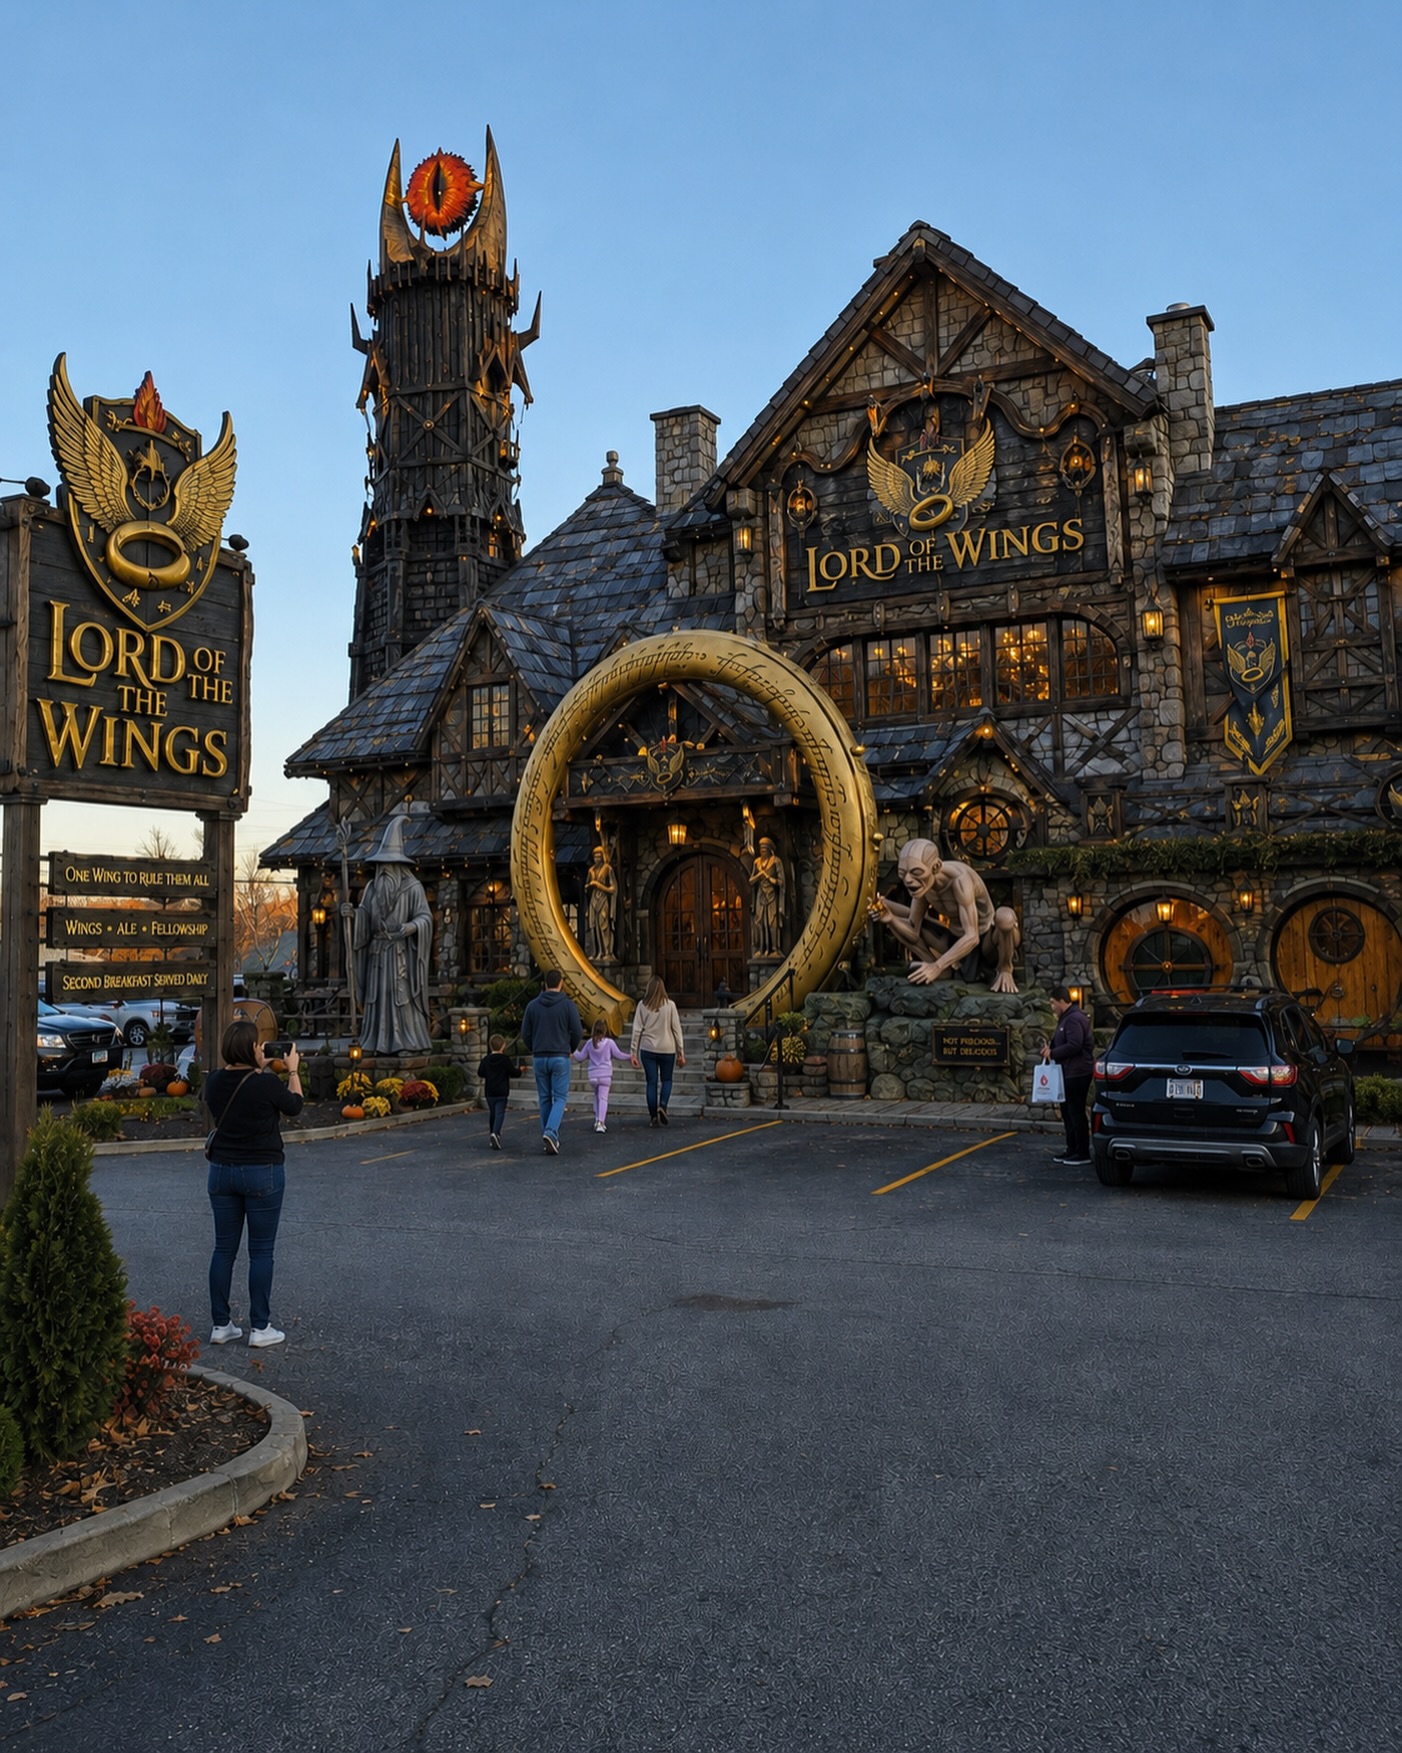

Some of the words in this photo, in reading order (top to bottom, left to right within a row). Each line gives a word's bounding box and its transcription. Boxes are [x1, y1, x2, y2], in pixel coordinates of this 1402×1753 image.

[909, 537, 936, 557] OF
[945, 518, 1085, 569] WINGS
[806, 543, 900, 593] LORD
[904, 554, 944, 574] THE
[47, 600, 186, 690] LORD
[193, 647, 226, 674] OF
[117, 684, 168, 717] THE
[187, 673, 233, 704] THE
[36, 697, 228, 778] WINGS
[65, 865, 90, 883] ONE
[92, 867, 121, 884] WING
[123, 871, 137, 884] TO
[139, 871, 163, 887] RULE
[165, 872, 191, 886] THEM
[193, 873, 209, 887] ALL
[65, 919, 103, 936] WINGS
[116, 922, 137, 936] ALE
[151, 920, 209, 936] FELLOWSHIP
[62, 974, 102, 990] SECOND
[103, 974, 153, 989] BREAKFAST
